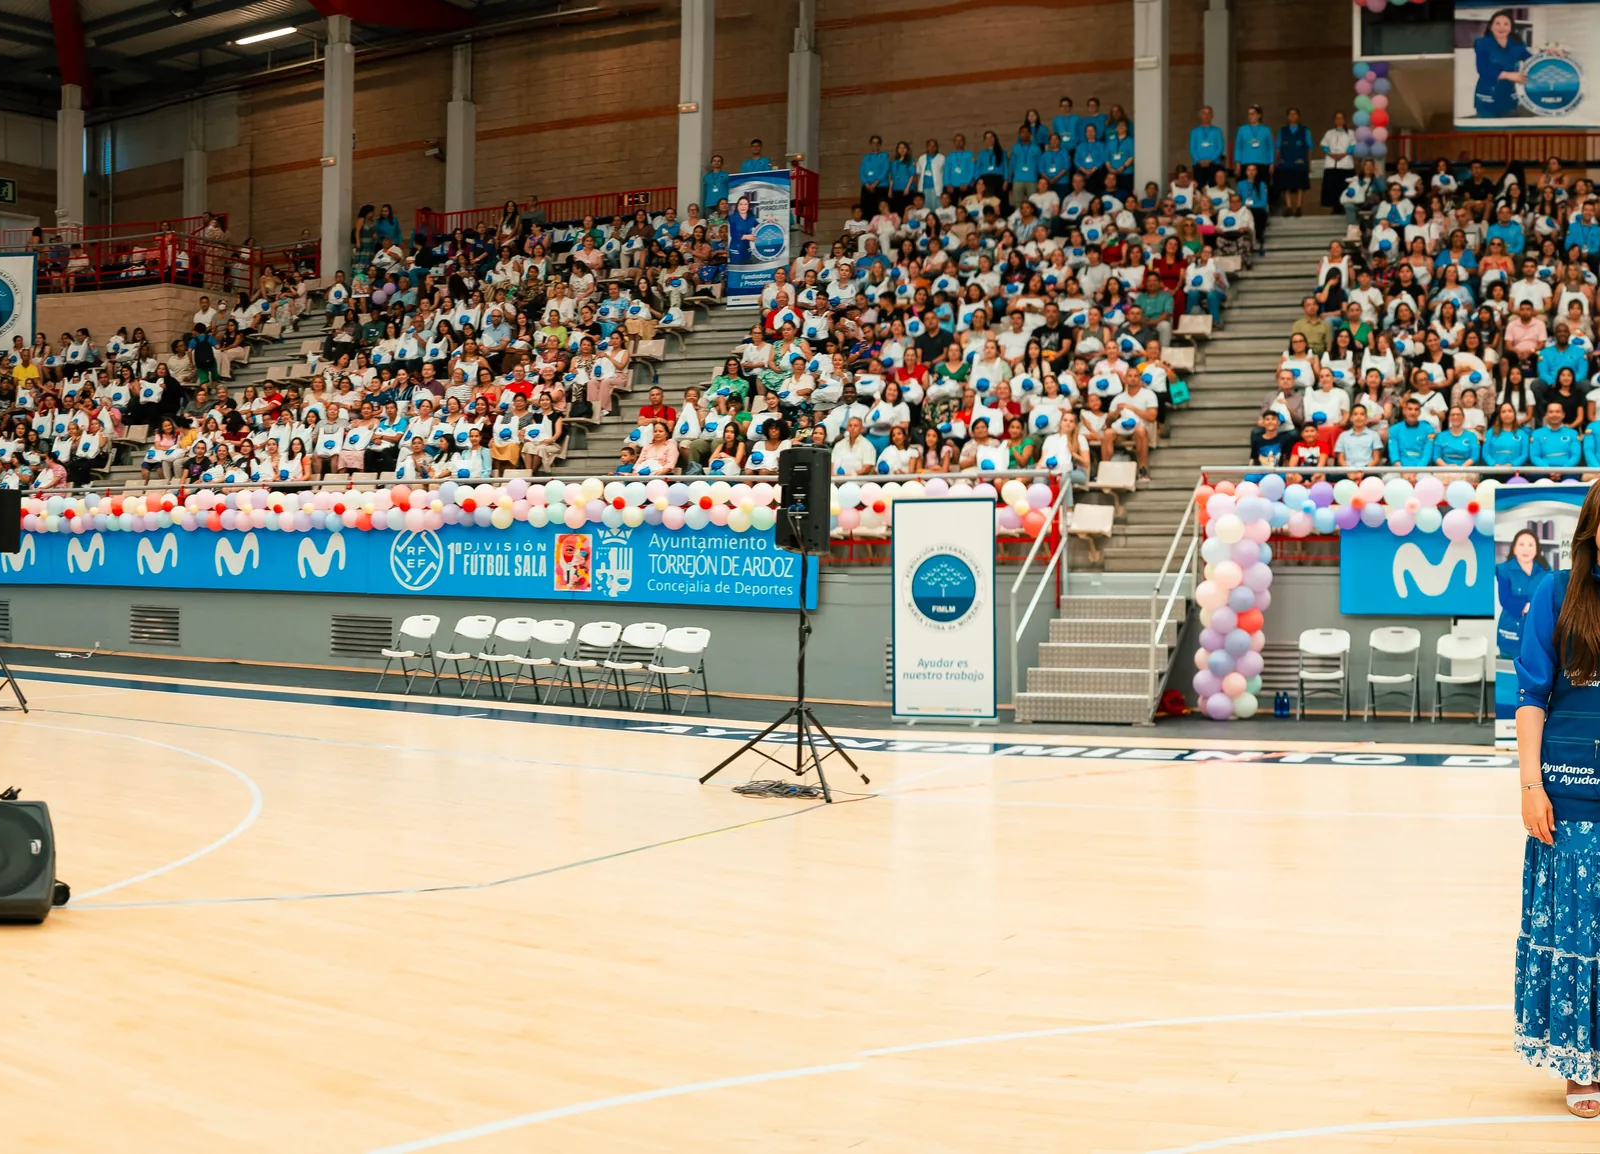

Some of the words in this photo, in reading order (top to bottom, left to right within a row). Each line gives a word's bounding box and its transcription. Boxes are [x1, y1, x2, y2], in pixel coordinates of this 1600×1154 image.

[464, 540, 547, 552] DIVISIÓN
[649, 532, 767, 552] Ayuntamiento
[463, 552, 511, 577] FÚTBOL
[514, 555, 547, 578] SALA
[648, 552, 718, 580] TORREJÓN
[720, 556, 743, 577] DE
[744, 556, 794, 578] ARDOZ
[647, 578, 712, 594] Concejalía
[715, 580, 729, 593] de
[733, 582, 793, 598] Deportes
[917, 658, 954, 669] Ayudar
[957, 660, 968, 669] es
[903, 671, 942, 681] nuestro
[945, 670, 984, 682] trabajo
[1541, 763, 1594, 775] Ayudanos
